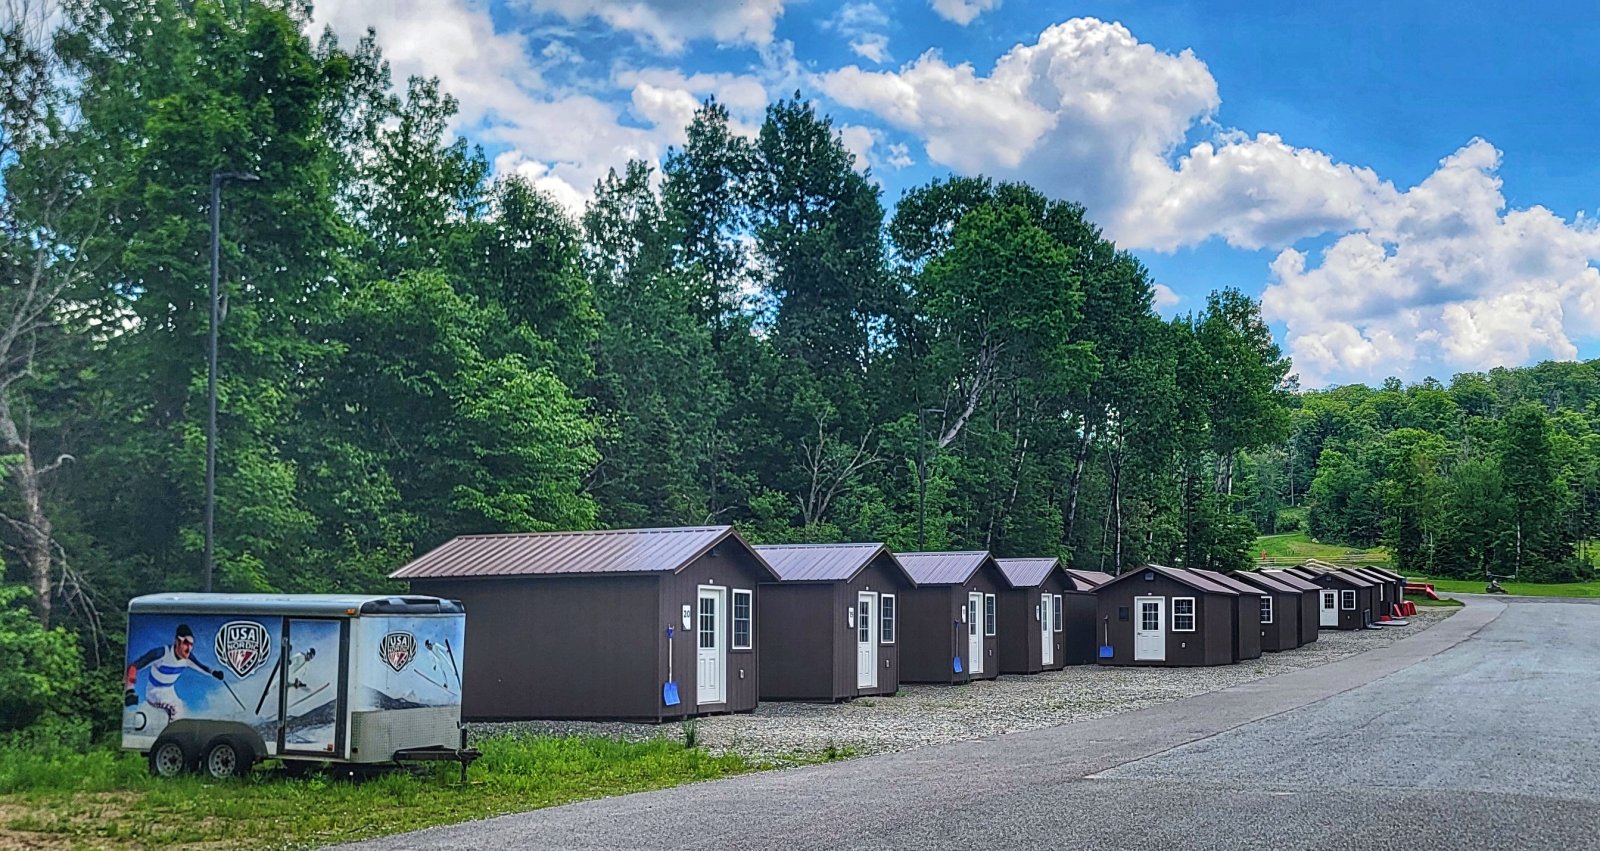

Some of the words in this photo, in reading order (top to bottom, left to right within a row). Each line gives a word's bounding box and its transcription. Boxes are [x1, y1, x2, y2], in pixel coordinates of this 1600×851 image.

[231, 628, 255, 640] USA
[391, 636, 407, 646] USA
[228, 642, 258, 651] NORDIC
